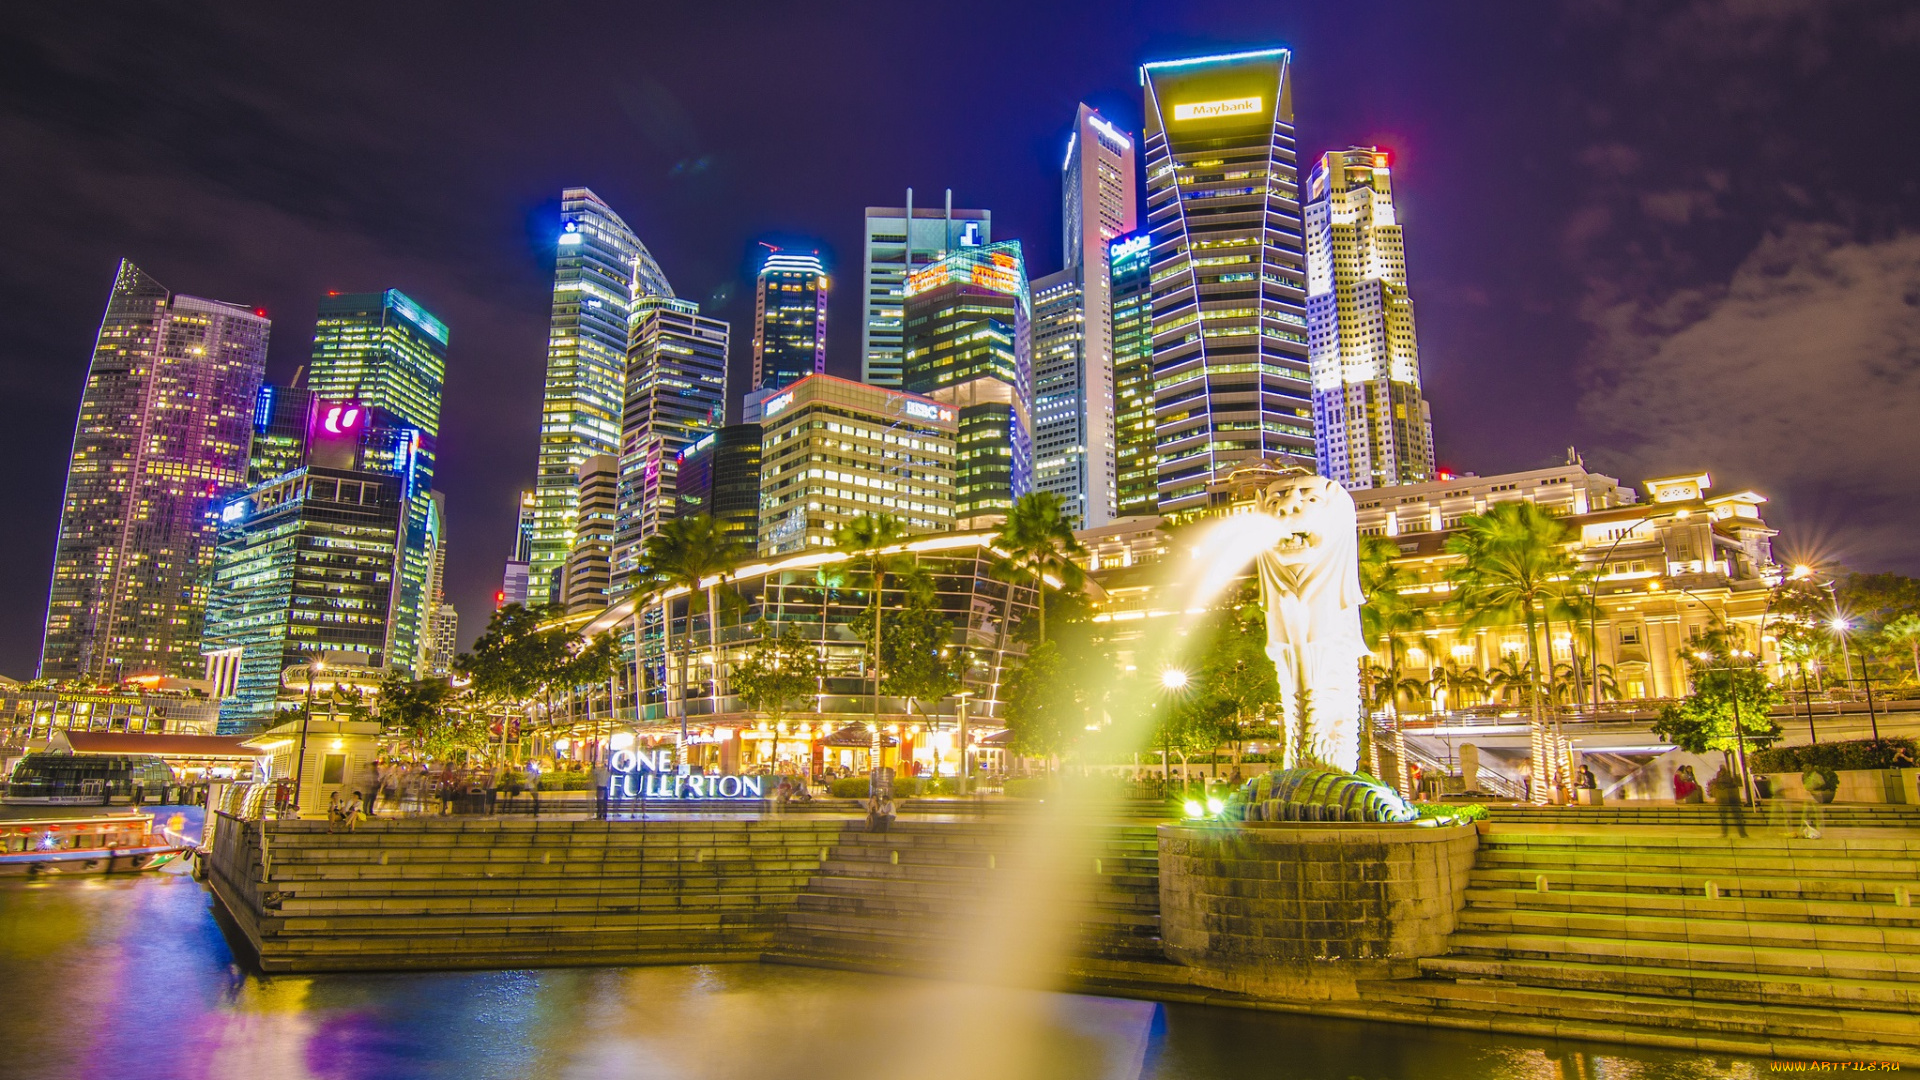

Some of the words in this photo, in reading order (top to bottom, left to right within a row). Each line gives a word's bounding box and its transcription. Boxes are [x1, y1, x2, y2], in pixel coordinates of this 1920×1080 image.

[1193, 100, 1253, 115] Maybank
[971, 273, 1014, 291] TRADING
[972, 264, 1014, 282] STRAITS
[906, 400, 938, 420] HSBC
[59, 694, 71, 702] THE
[72, 694, 108, 704] FULLERTON
[611, 750, 672, 772] ONE
[609, 774, 761, 797] FULLERTON
